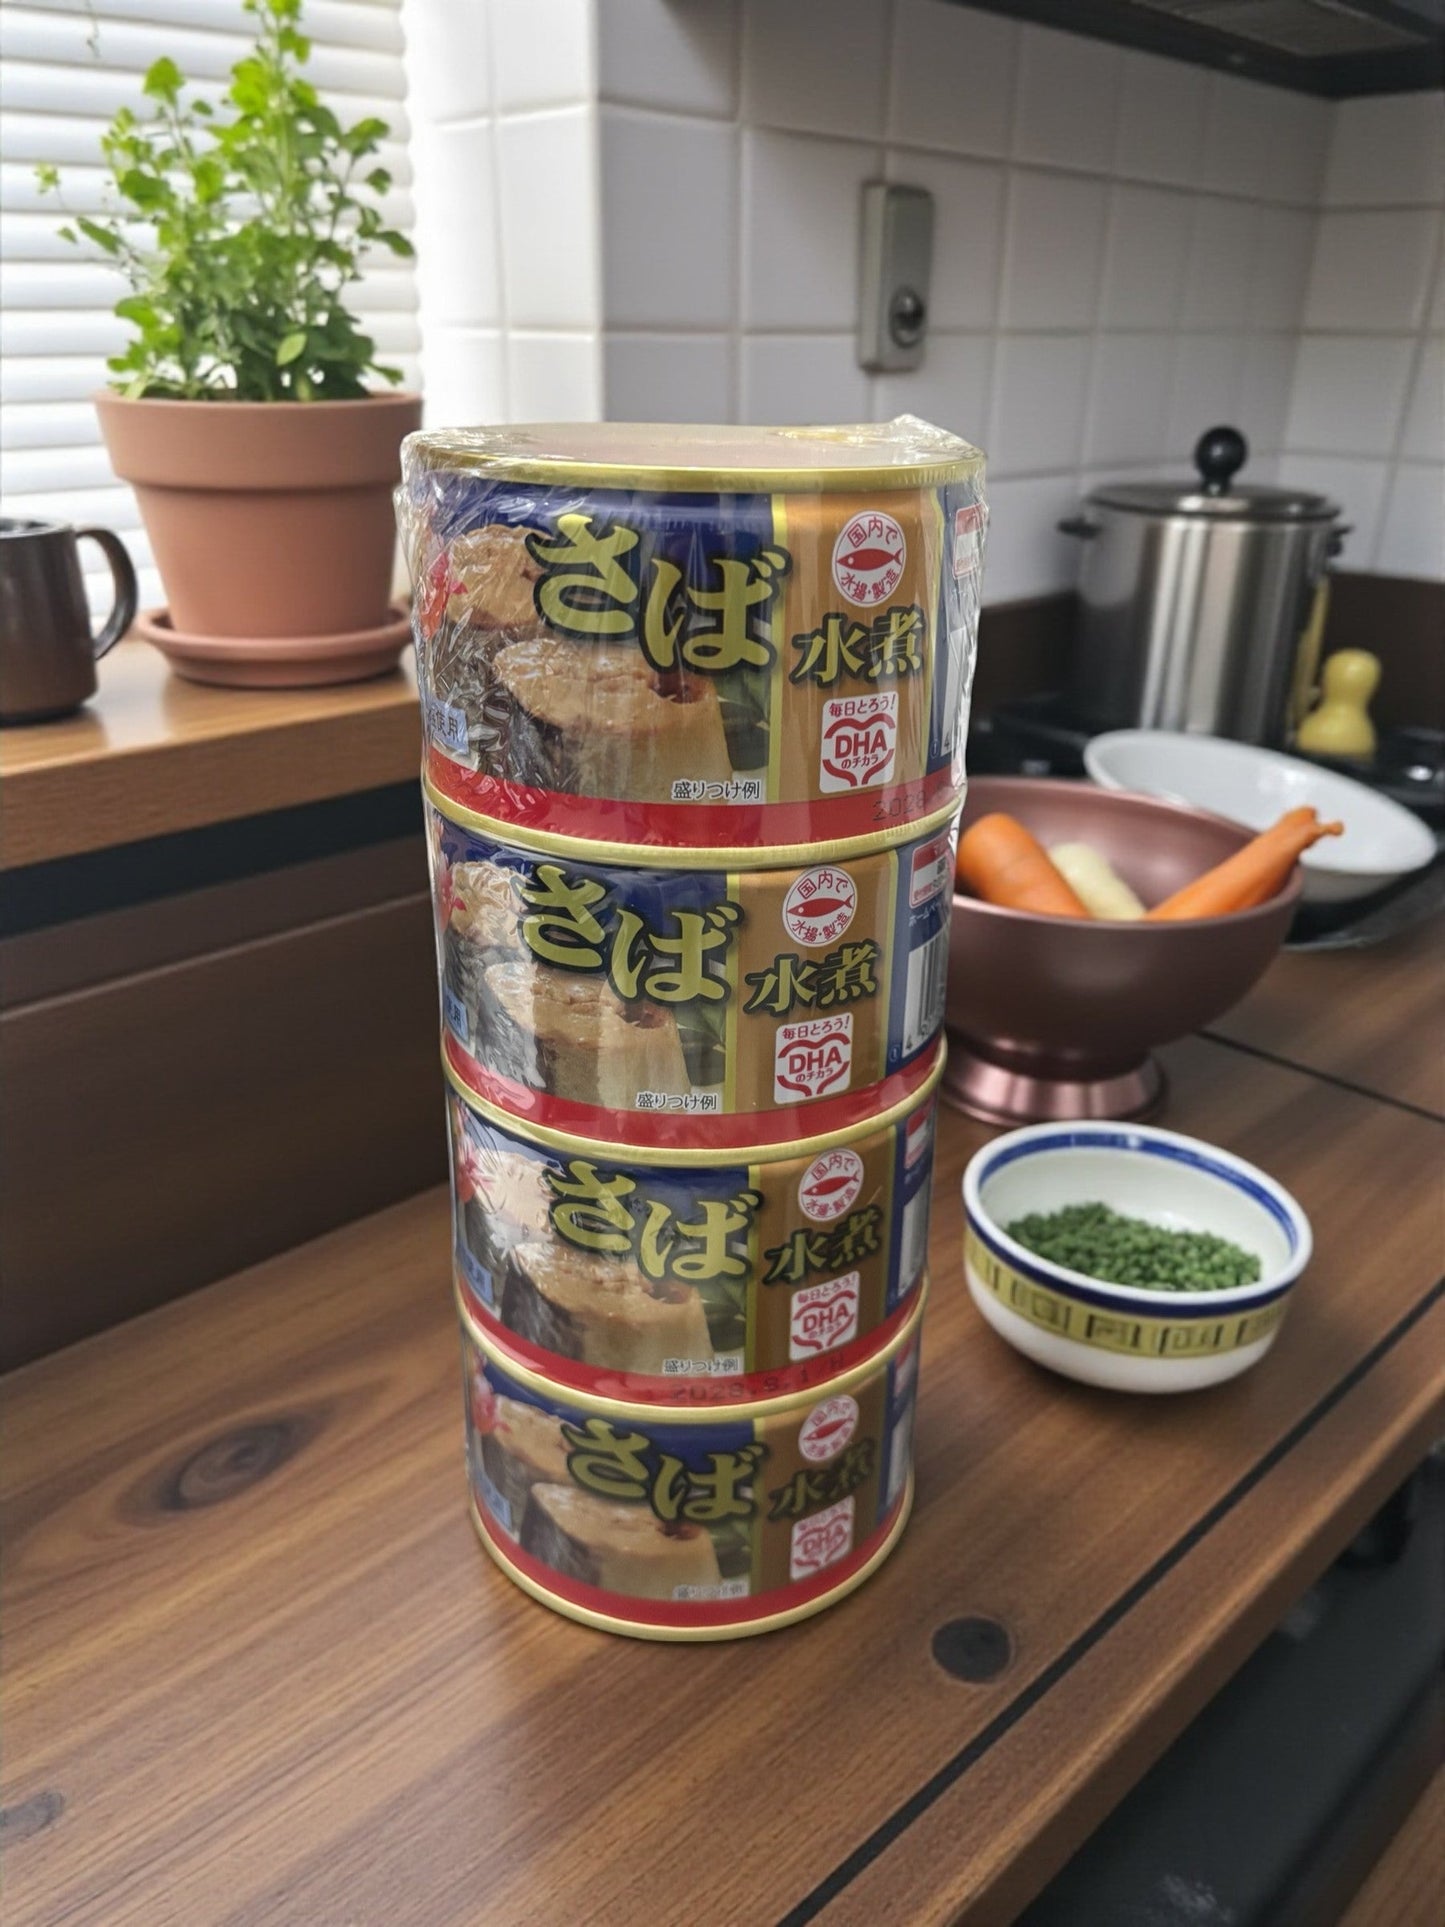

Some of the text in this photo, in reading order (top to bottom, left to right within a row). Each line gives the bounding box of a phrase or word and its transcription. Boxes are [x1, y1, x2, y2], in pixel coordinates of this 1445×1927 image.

[847, 516, 899, 549] 国内で
[527, 513, 793, 673] さば
[840, 568, 900, 602] 水揚・製造
[790, 604, 925, 690] 水煮
[829, 694, 897, 718] 毎日とろう!
[834, 729, 888, 759] DHA
[841, 754, 880, 770] のチカラ
[673, 779, 761, 800] 盛りつけ例
[797, 871, 849, 900] 国内で
[514, 863, 745, 1005] さば
[792, 912, 850, 943] 水揚・製造
[743, 940, 880, 1016] 水煮
[782, 1015, 850, 1040] 毎日とろう!
[789, 1046, 843, 1075] DHA
[795, 1067, 834, 1083] のチカラ
[637, 1091, 718, 1111] 盛りつけ例
[544, 1160, 766, 1284] さば
[761, 1203, 884, 1286] 水煮
[803, 1302, 849, 1333] DHA
[560, 1418, 770, 1524] さば
